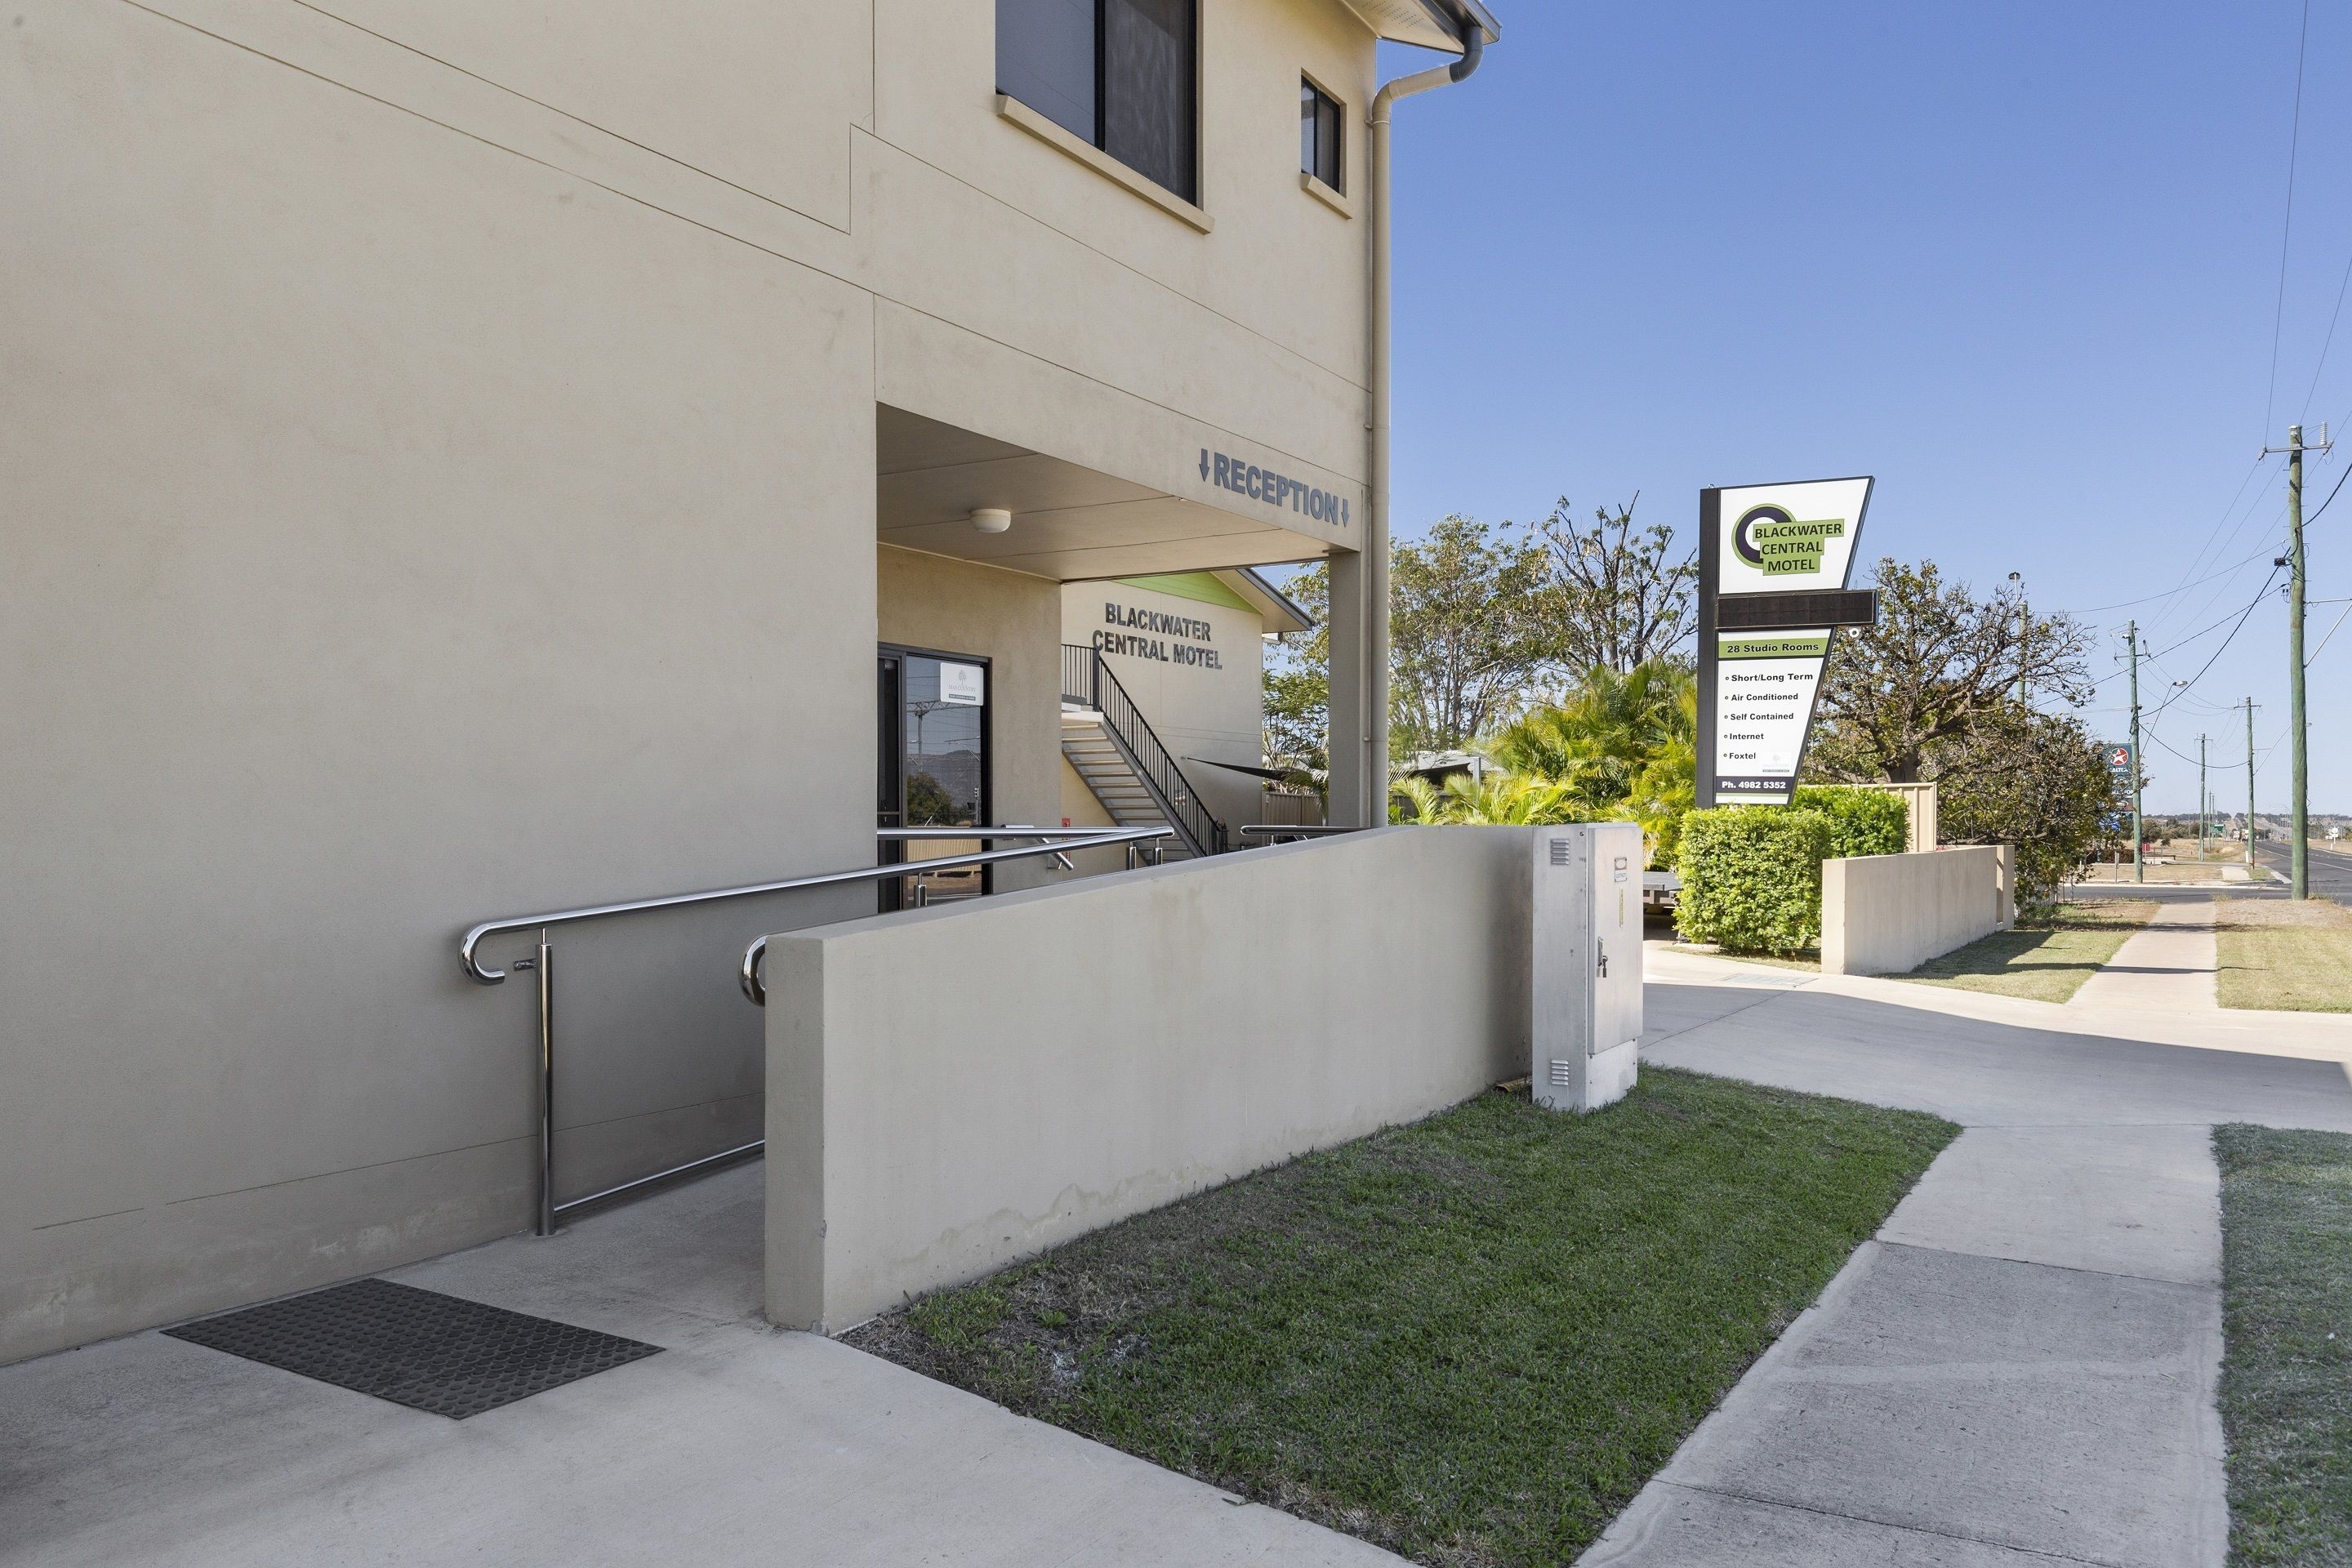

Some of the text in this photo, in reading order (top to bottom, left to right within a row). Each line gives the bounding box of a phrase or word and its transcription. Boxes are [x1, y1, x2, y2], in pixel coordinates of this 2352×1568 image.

[1214, 452, 1339, 526] RECEPTION
[1755, 523, 1842, 539] BLACKWATER
[1762, 541, 1823, 555] CENTRAL
[1768, 559, 1815, 572] MOTEL
[1105, 602, 1211, 642] BLACKWATER
[1092, 630, 1223, 670] CENTRAL MOTEL
[1726, 644, 1819, 653] 28 Studio Rooms
[1731, 674, 1784, 682] Short/Long
[1746, 693, 1798, 701] Conditioned
[1722, 781, 1736, 789] Ph.
[1738, 781, 1761, 789] 4982
